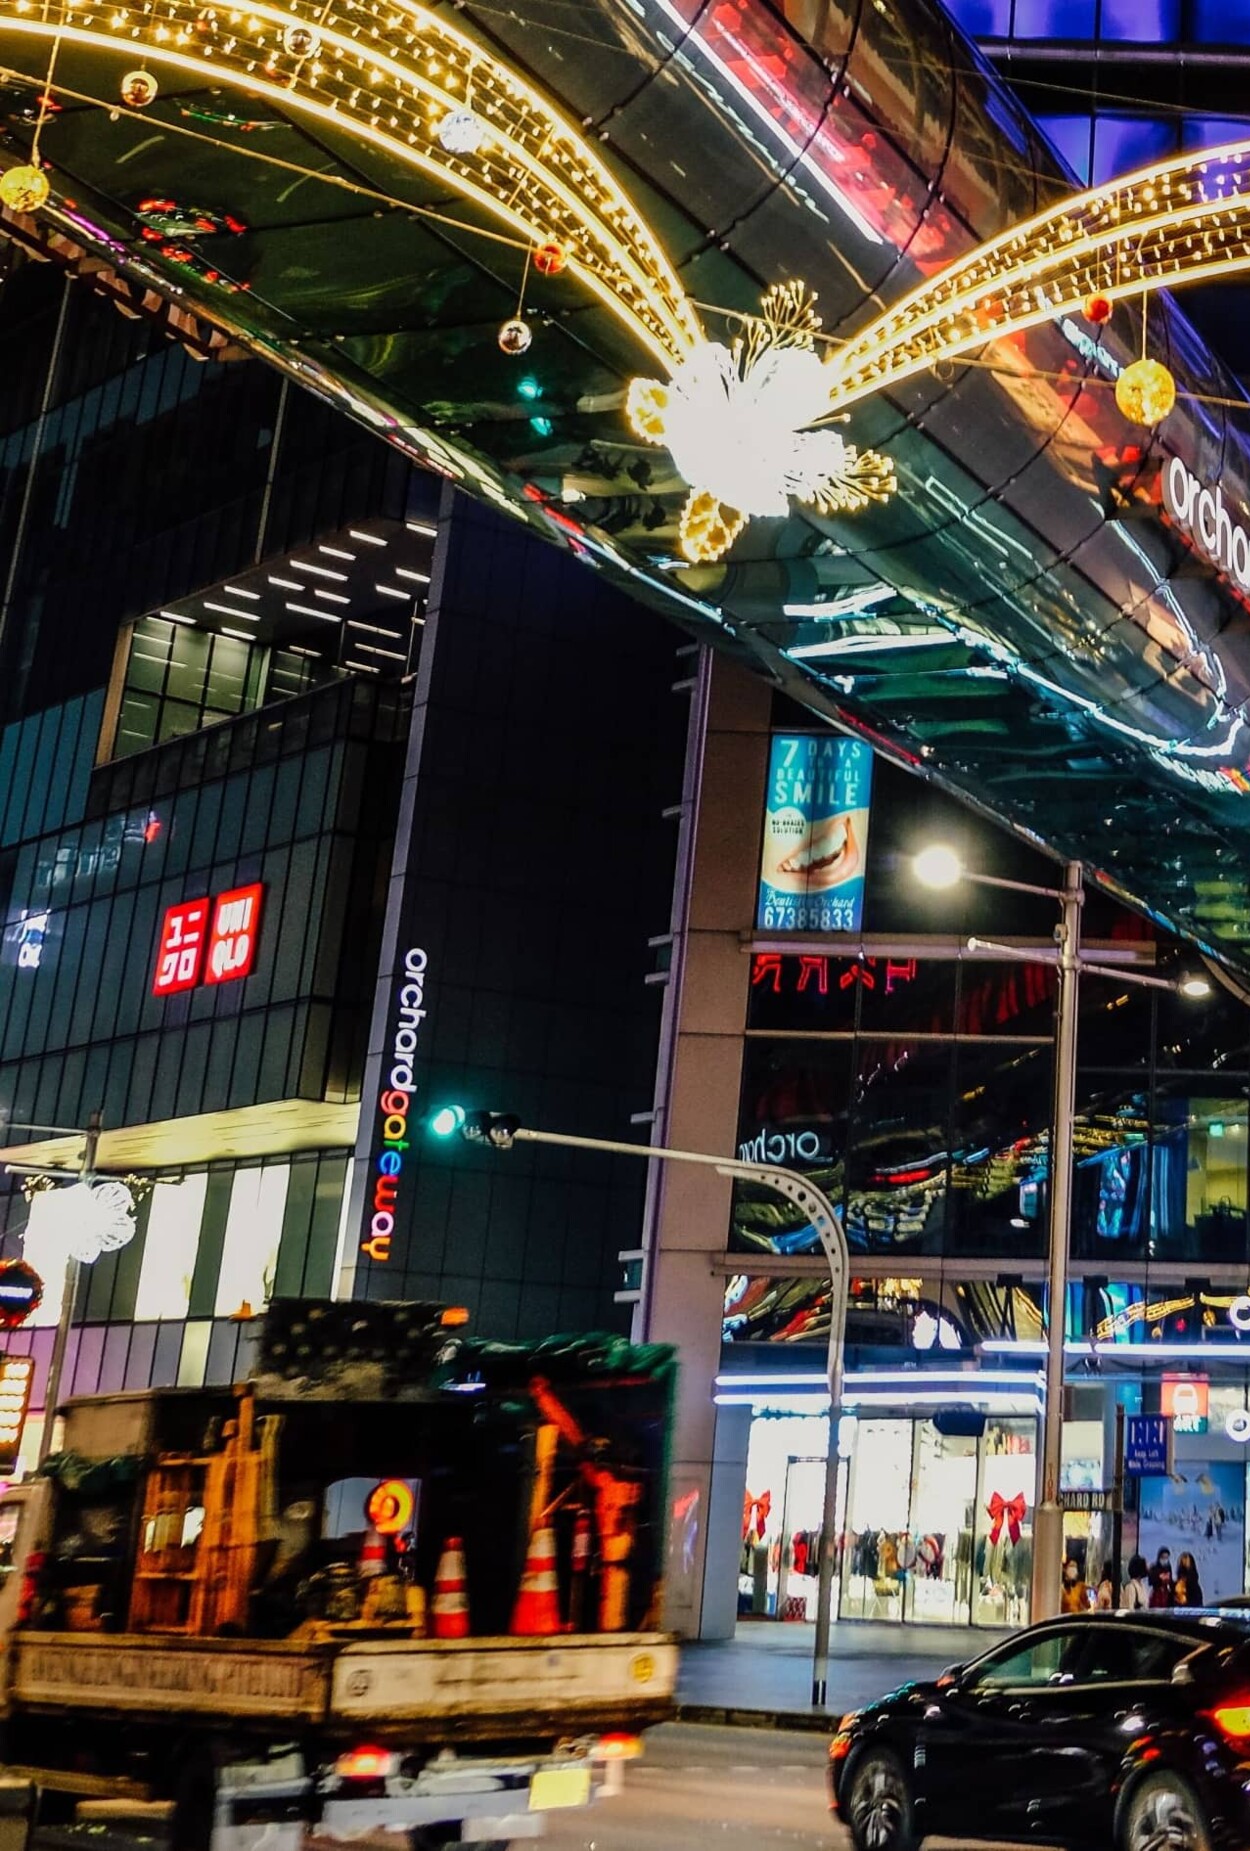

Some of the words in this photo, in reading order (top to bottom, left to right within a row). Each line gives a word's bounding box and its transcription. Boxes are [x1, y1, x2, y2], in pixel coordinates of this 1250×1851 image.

[780, 739, 799, 768] 7
[808, 740, 861, 758] DAYS
[774, 780, 858, 806] SMILE
[764, 906, 854, 931] 67385833
[361, 947, 427, 1261] orchardgateway
